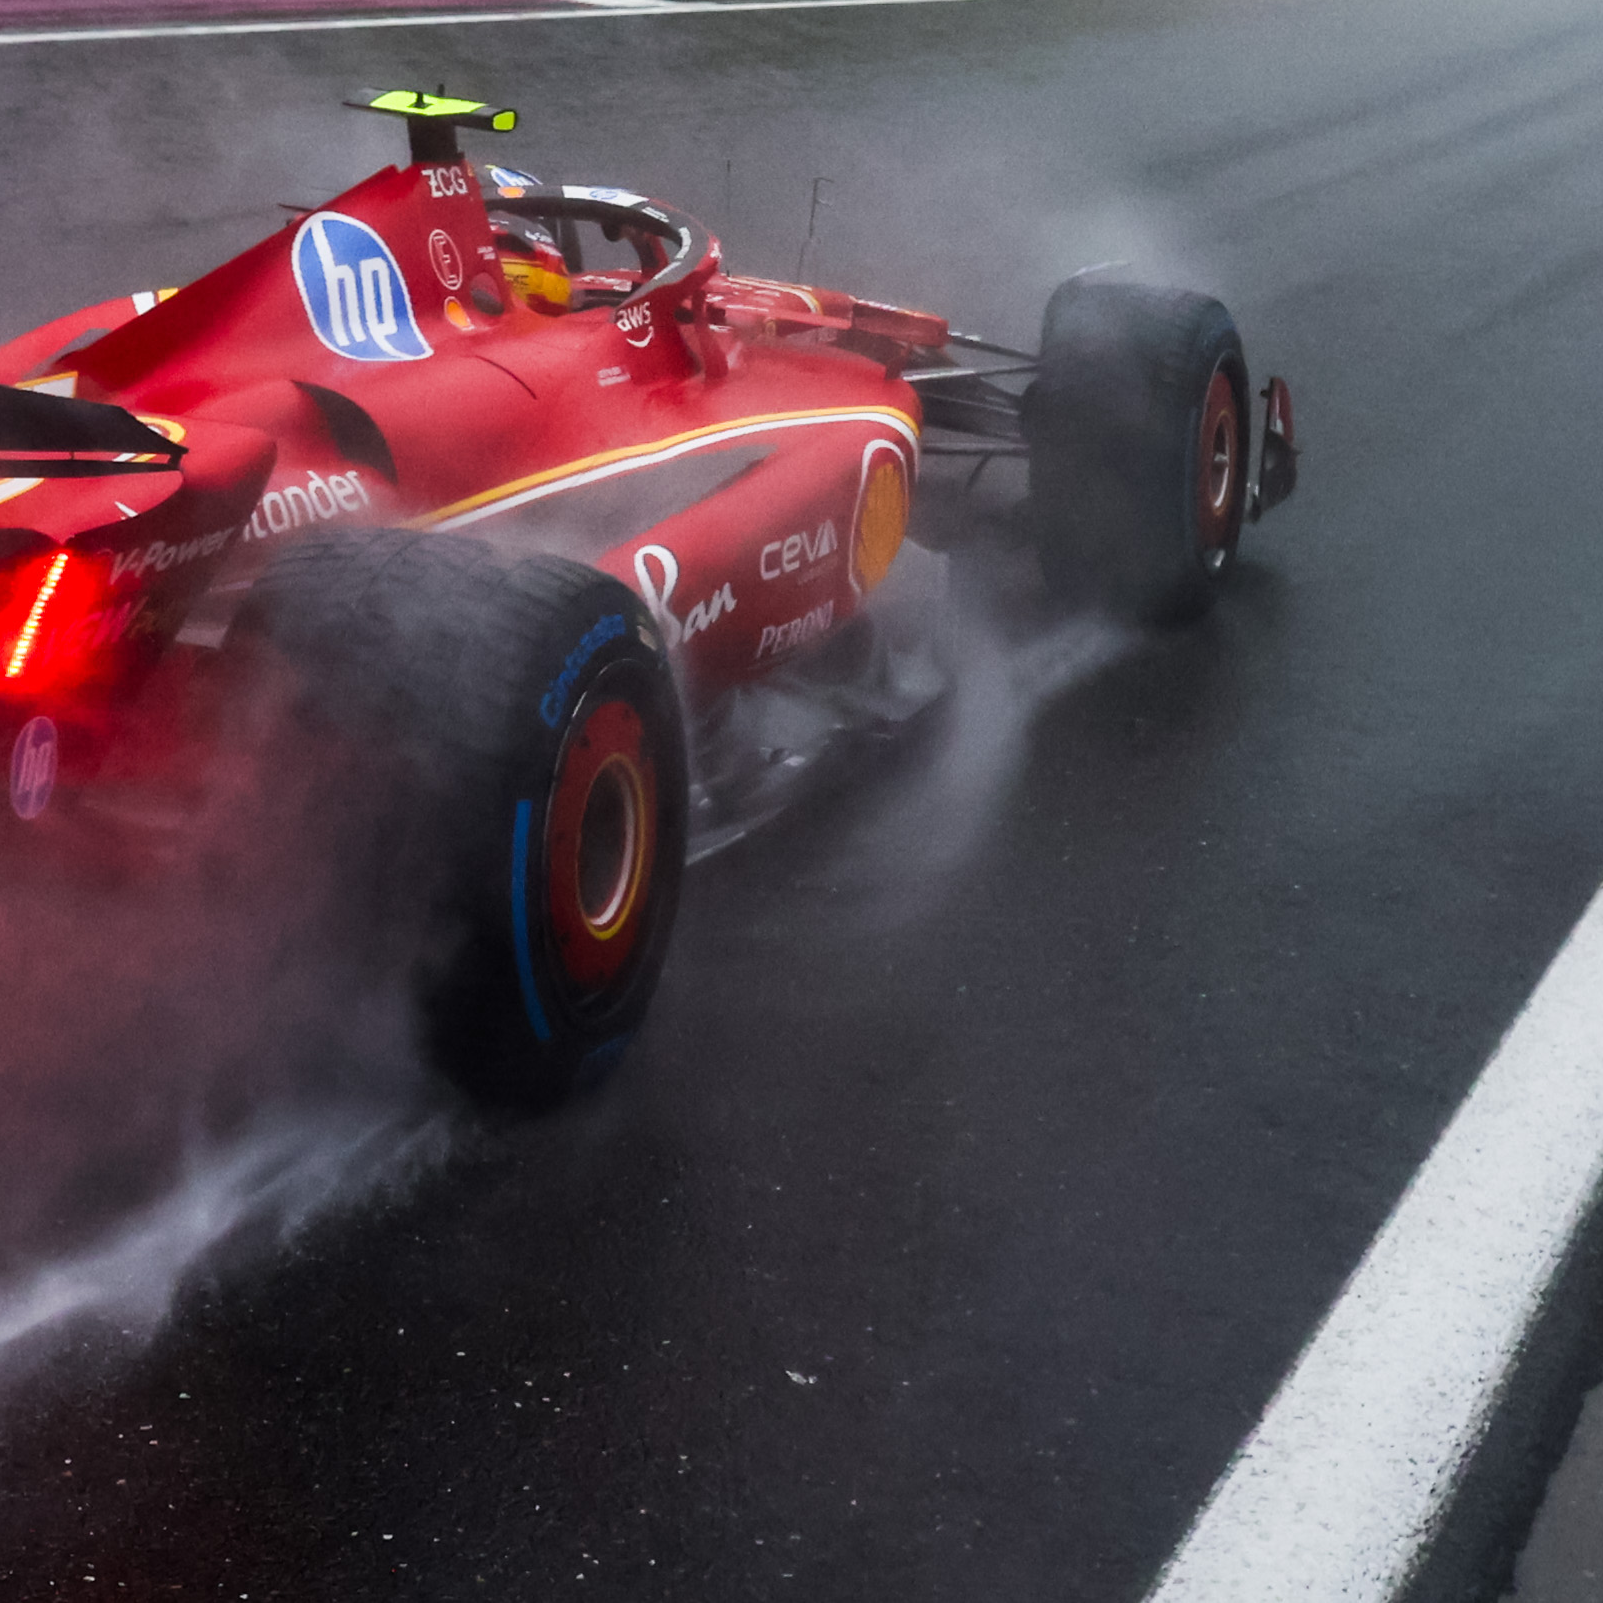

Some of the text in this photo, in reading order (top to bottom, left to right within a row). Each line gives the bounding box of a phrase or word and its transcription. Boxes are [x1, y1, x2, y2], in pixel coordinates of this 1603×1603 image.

[421, 166, 468, 197] ZCG
[308, 215, 407, 359] hp
[616, 301, 652, 333] aws
